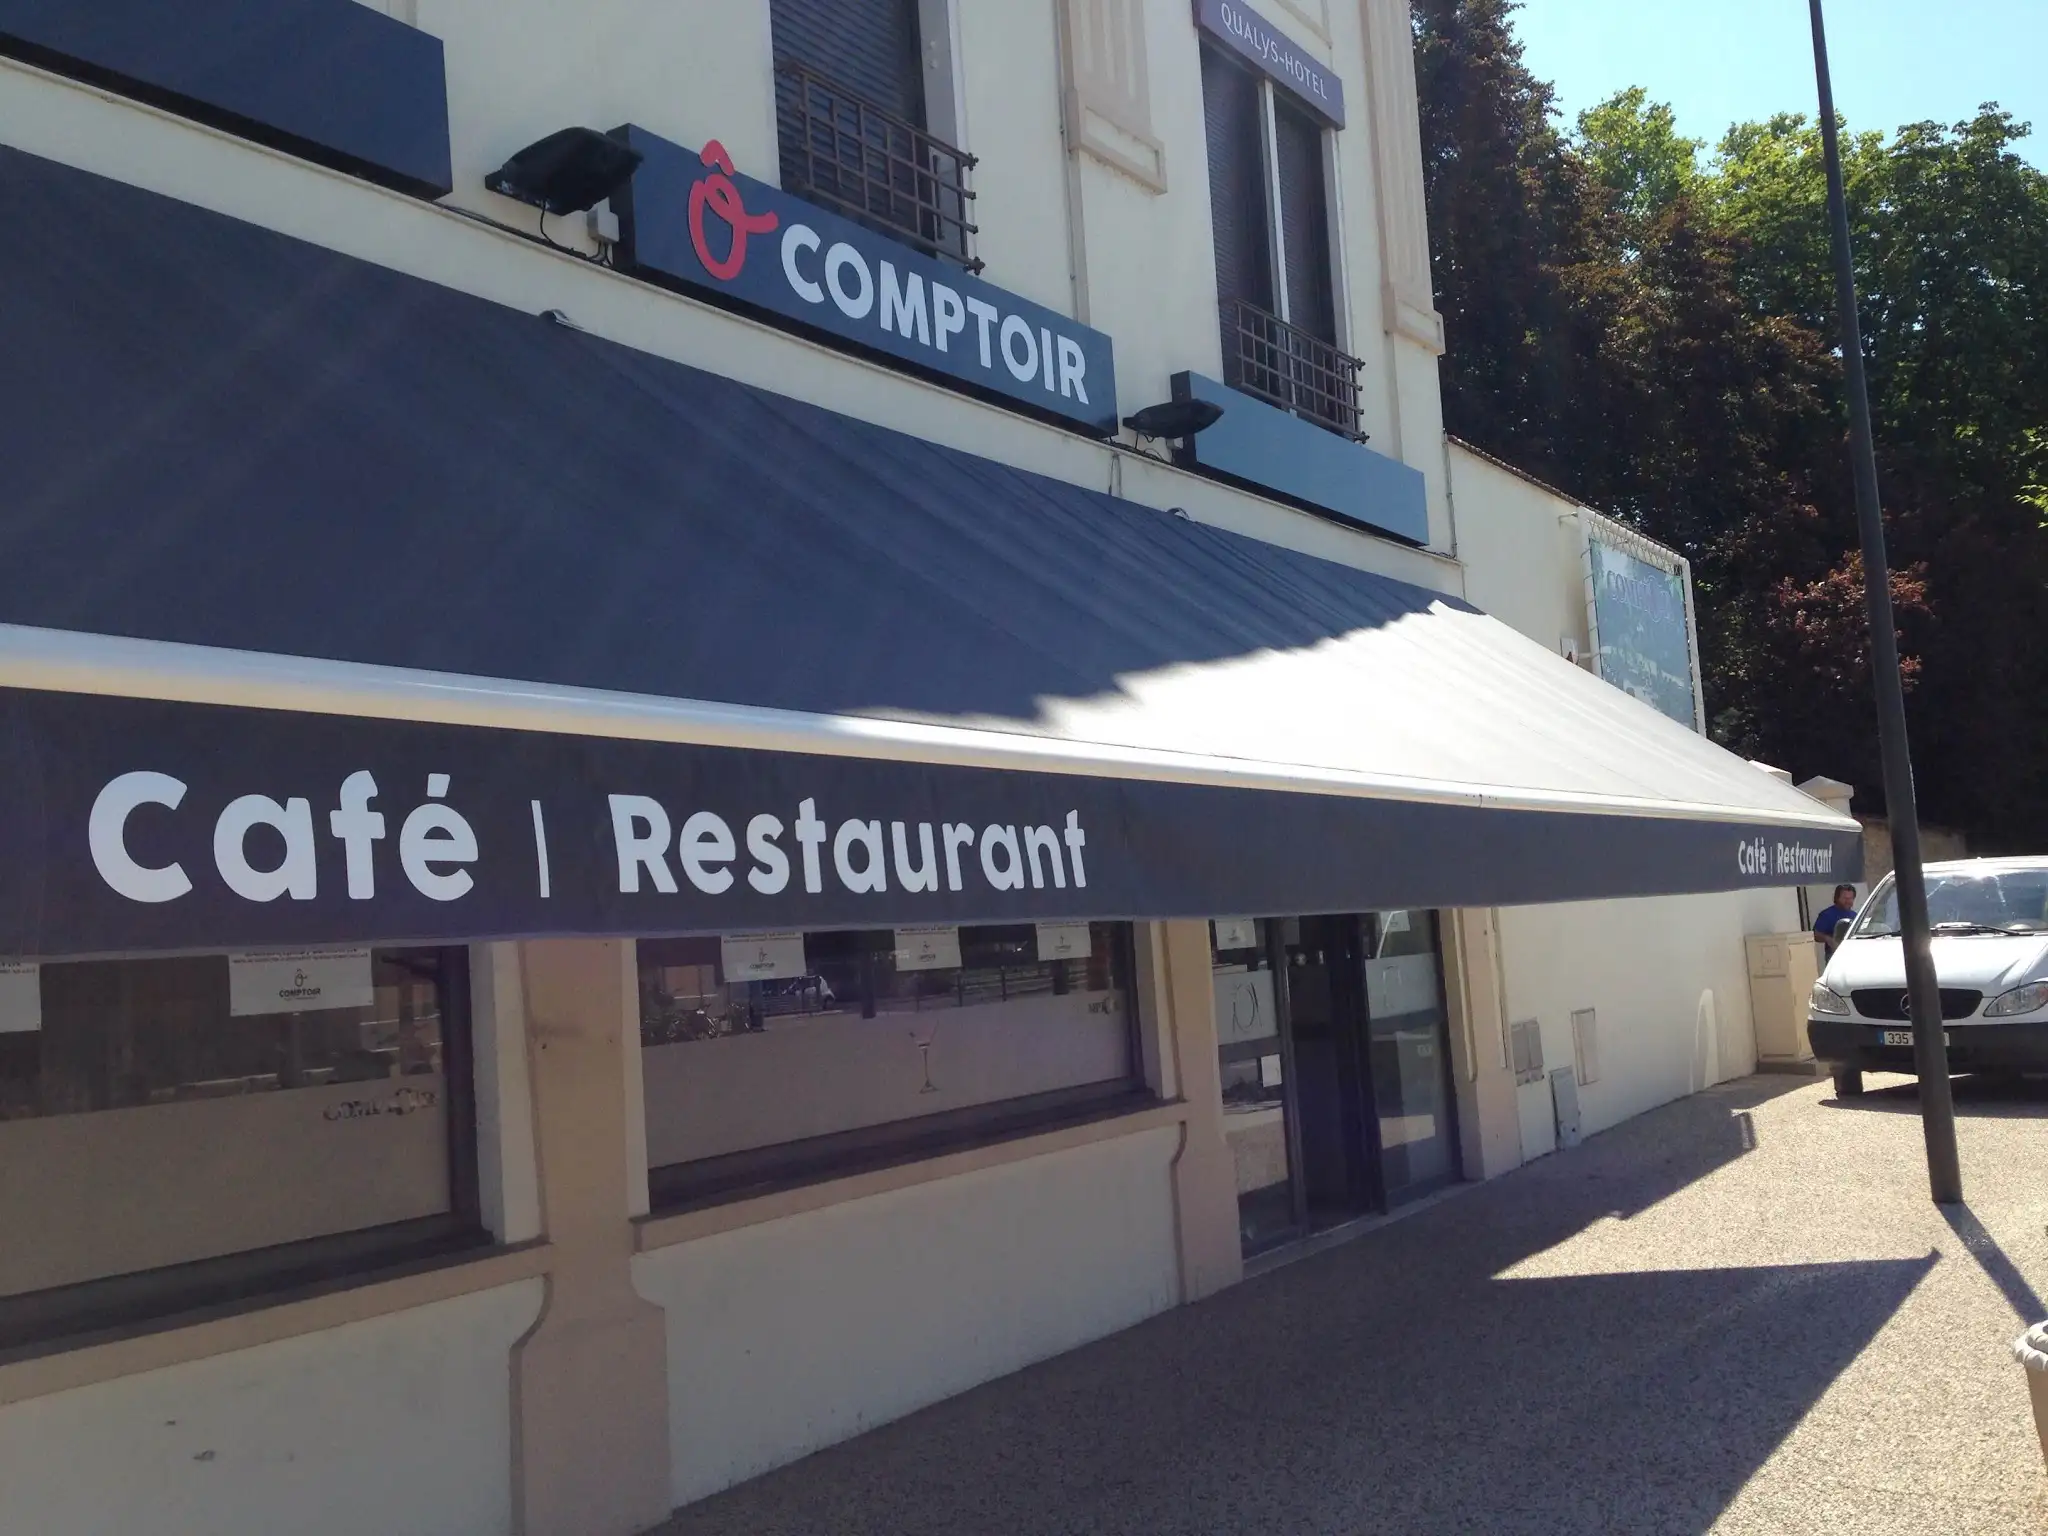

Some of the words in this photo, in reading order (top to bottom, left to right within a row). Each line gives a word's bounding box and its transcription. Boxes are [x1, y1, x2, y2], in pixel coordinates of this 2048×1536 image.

[1220, 2, 1328, 101] QUALYS-HOTEL
[781, 224, 1090, 405] COMPTOIR
[87, 769, 479, 904] Café
[607, 793, 1088, 896] Restaurant
[1777, 841, 1832, 873] Restaurant
[1887, 1032, 1909, 1045] 335
